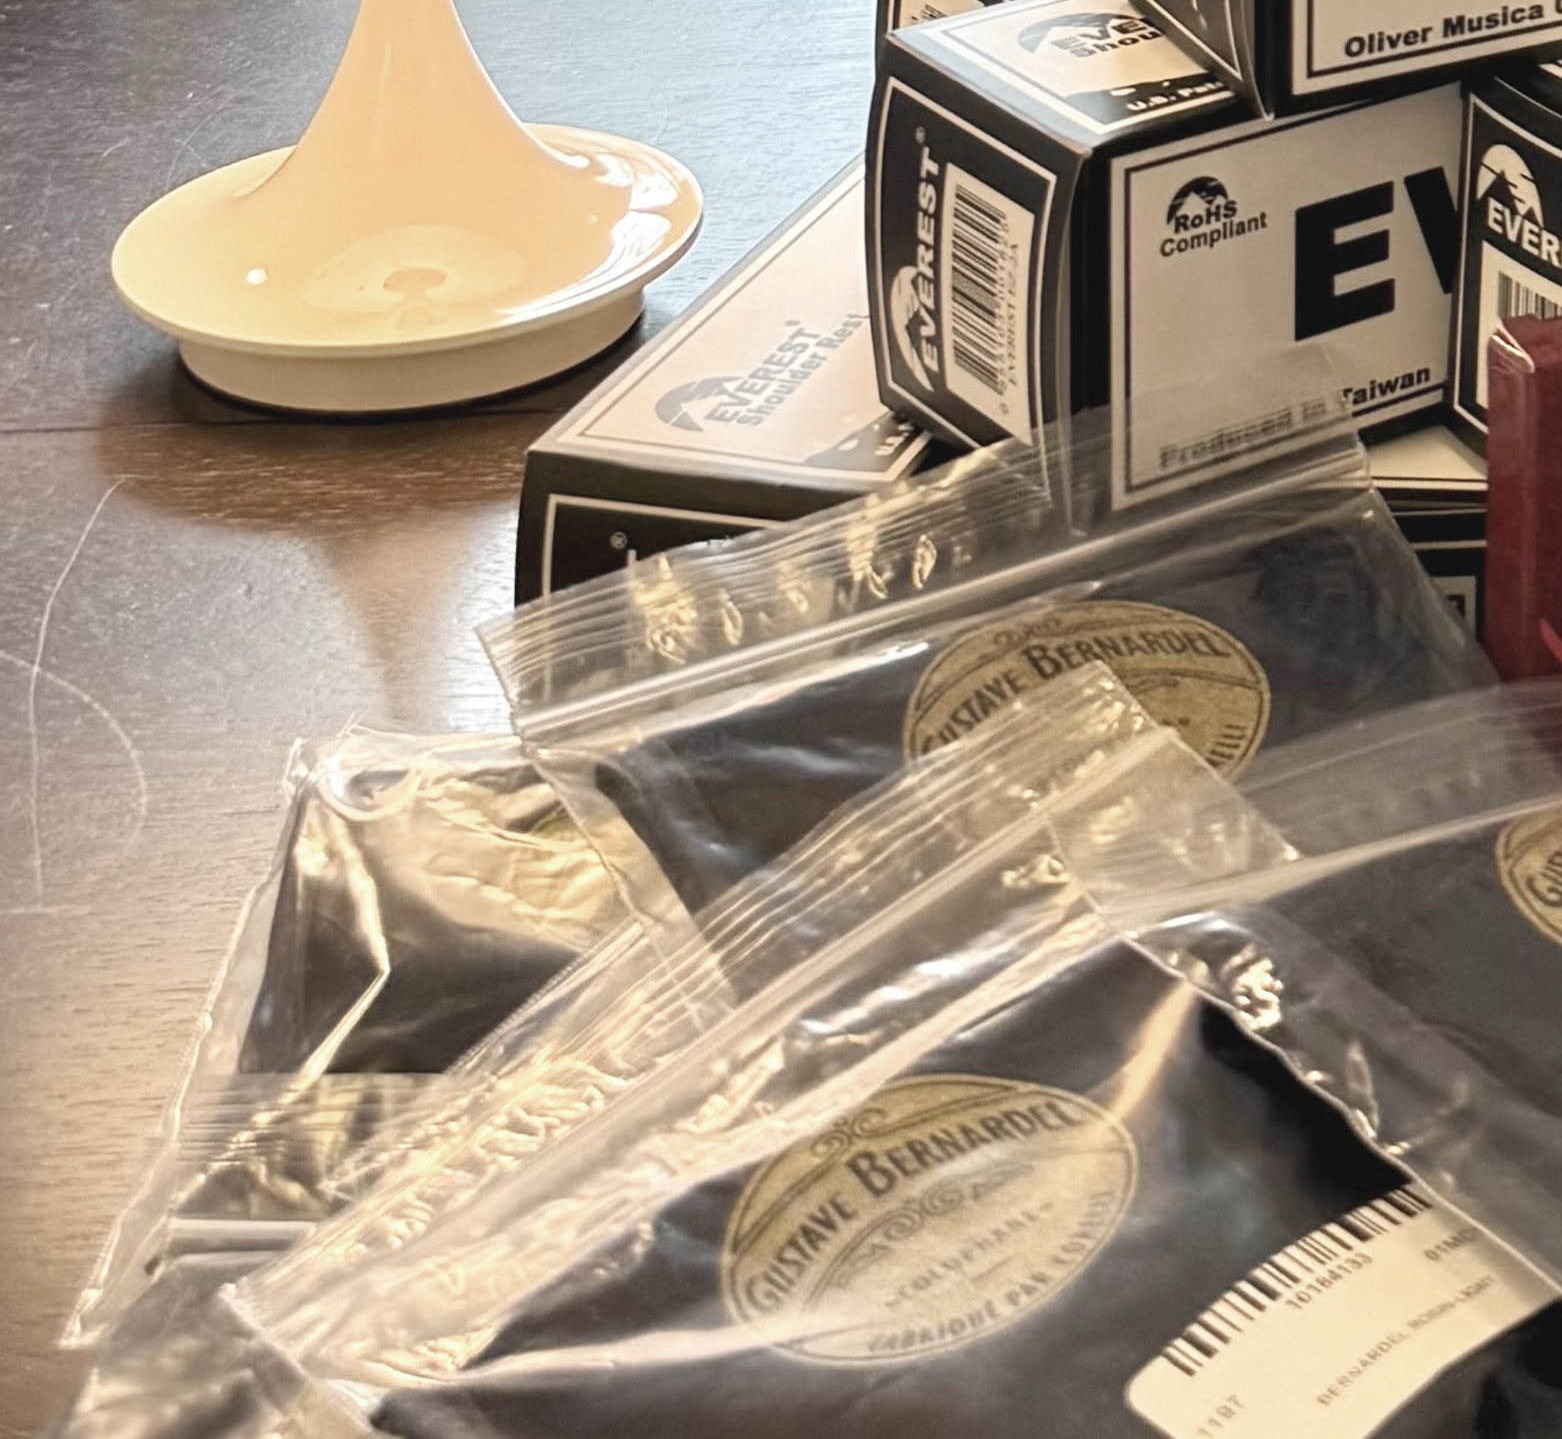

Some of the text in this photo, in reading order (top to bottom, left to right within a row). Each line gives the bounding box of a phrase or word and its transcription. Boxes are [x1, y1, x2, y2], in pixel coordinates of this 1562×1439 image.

[1344, 21, 1433, 58] Oliver
[1441, 3, 1546, 40] Musica
[1160, 211, 1268, 258] Compliant
[1173, 198, 1239, 234] RoHS
[920, 146, 941, 374] EVEREST
[704, 326, 822, 424] EVEREST
[736, 350, 828, 428] Shoulder
[1340, 366, 1431, 406] Taiwan
[743, 1098, 1078, 1315] GUSTAVE BERNARDEL
